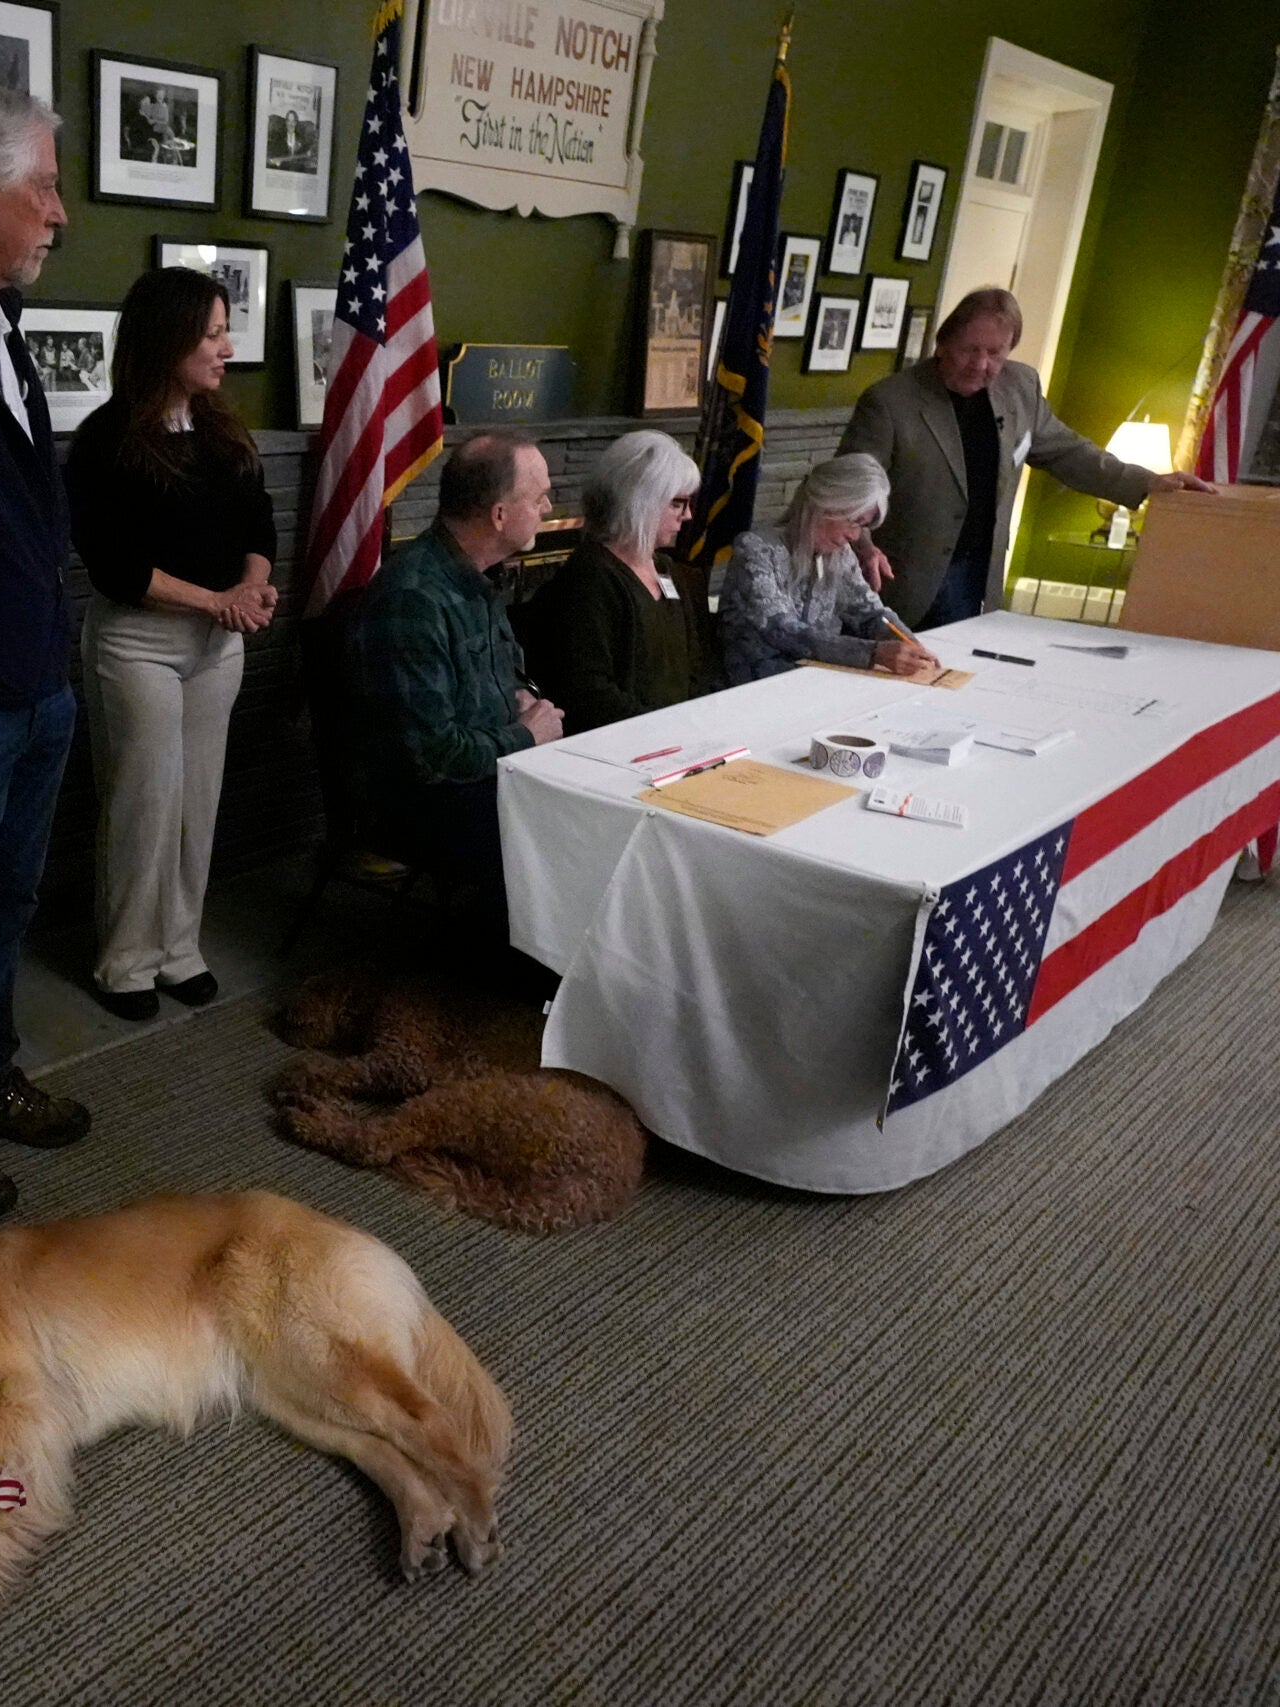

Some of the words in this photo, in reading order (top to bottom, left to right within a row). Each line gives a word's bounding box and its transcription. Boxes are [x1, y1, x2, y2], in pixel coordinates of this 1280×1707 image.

[555, 15, 633, 73] NOTCH
[450, 52, 495, 92] NEW
[509, 66, 613, 118] HAMPSHIRE
[508, 115, 522, 152] in
[528, 111, 550, 156] the
[487, 358, 545, 380] BALLOT
